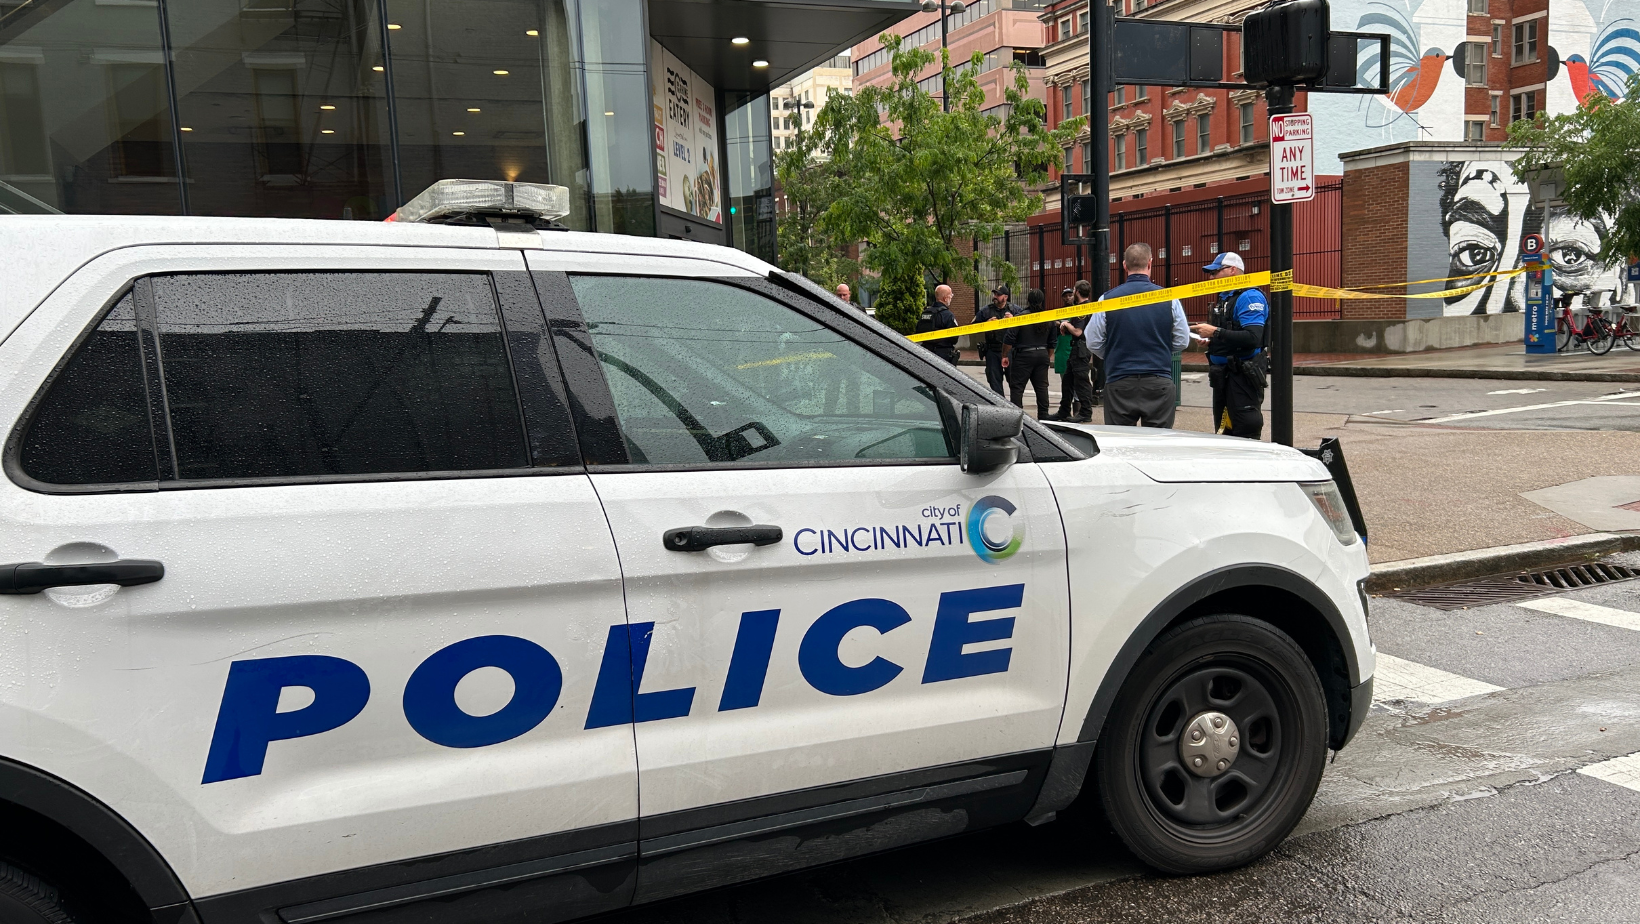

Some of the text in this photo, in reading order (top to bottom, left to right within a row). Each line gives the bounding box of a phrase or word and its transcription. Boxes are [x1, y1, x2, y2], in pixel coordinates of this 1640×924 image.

[668, 98, 690, 130] EATERY
[1284, 118, 1310, 127] STOPPING
[1272, 120, 1284, 137] NO
[1285, 128, 1310, 137] PARKING
[673, 140, 691, 164] LEVEL 2
[1281, 145, 1304, 163] ANY
[1280, 165, 1306, 182] TIME
[1276, 186, 1295, 195] TOW ZONE
[1527, 239, 1536, 250] B
[921, 504, 961, 520] city of
[793, 521, 964, 556] CINCINNATI
[200, 583, 1025, 785] POLICE
